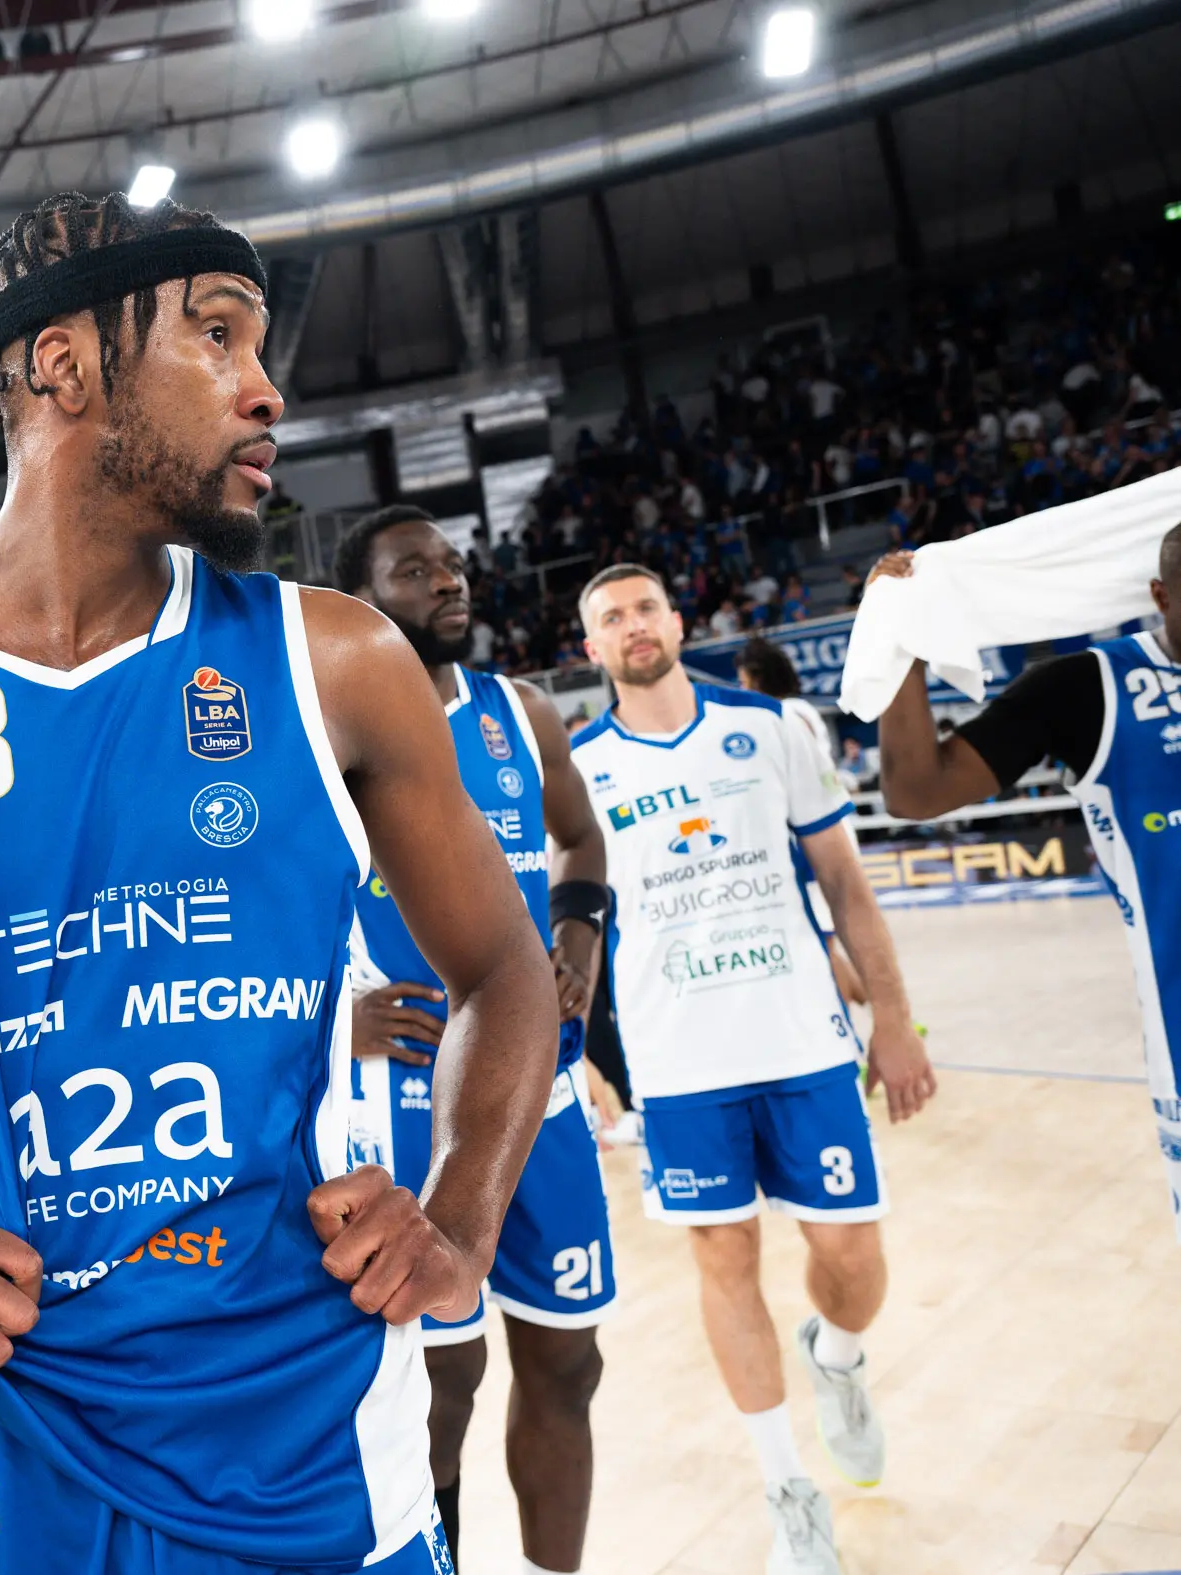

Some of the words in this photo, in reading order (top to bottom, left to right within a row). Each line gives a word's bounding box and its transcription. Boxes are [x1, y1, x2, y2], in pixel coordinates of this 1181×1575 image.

[194, 704, 241, 721] LBA
[202, 735, 241, 751] Unipol
[195, 787, 253, 814] PALLACANESTRO
[635, 785, 700, 817] BTL
[200, 826, 250, 843] BRESCIA
[506, 851, 548, 874] EGRA
[643, 866, 695, 891] BORGO
[698, 849, 768, 876] SPURGHI
[93, 877, 230, 905] METROLOGIA
[9, 1061, 233, 1182] a2a
[819, 1145, 856, 1196] 3
[26, 1195, 59, 1226] FE
[66, 1176, 234, 1218] COMPANY
[552, 1239, 603, 1301] 21
